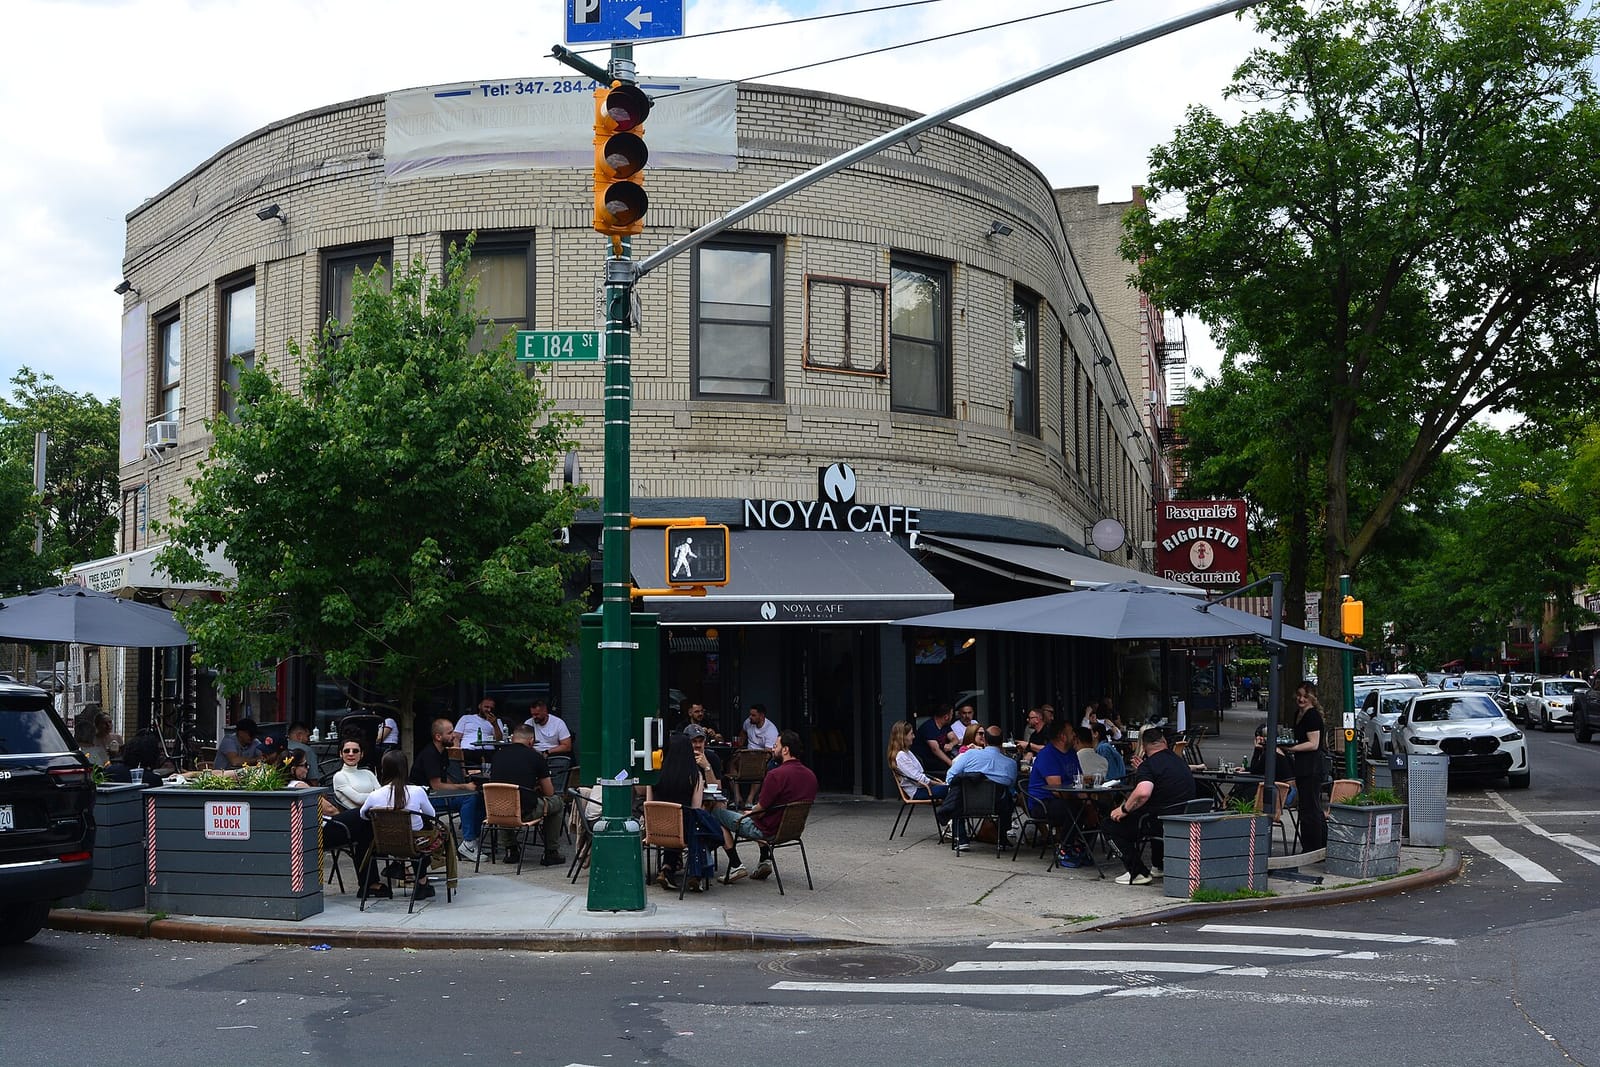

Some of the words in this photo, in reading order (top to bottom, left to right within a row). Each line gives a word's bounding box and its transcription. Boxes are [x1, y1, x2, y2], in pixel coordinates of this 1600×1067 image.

[575, 0, 599, 23] P
[480, 84, 509, 97] Tel:
[515, 80, 611, 95] 347-284-4
[525, 336, 534, 357] E
[543, 335, 574, 357] 184
[582, 333, 593, 347] St
[744, 499, 838, 530] NOYA
[847, 504, 921, 534] CAFE
[1166, 504, 1237, 520] Pasquale's
[1162, 526, 1239, 551] RIGOLETTO
[88, 572, 100, 583] FREE
[100, 567, 125, 580] DELIVERY
[1164, 569, 1240, 584] Restaurant
[782, 604, 811, 613] NOYA
[816, 604, 844, 613] CAFE
[212, 806, 223, 816] DO
[226, 806, 241, 816] NOT
[214, 819, 240, 829] BLOCK
